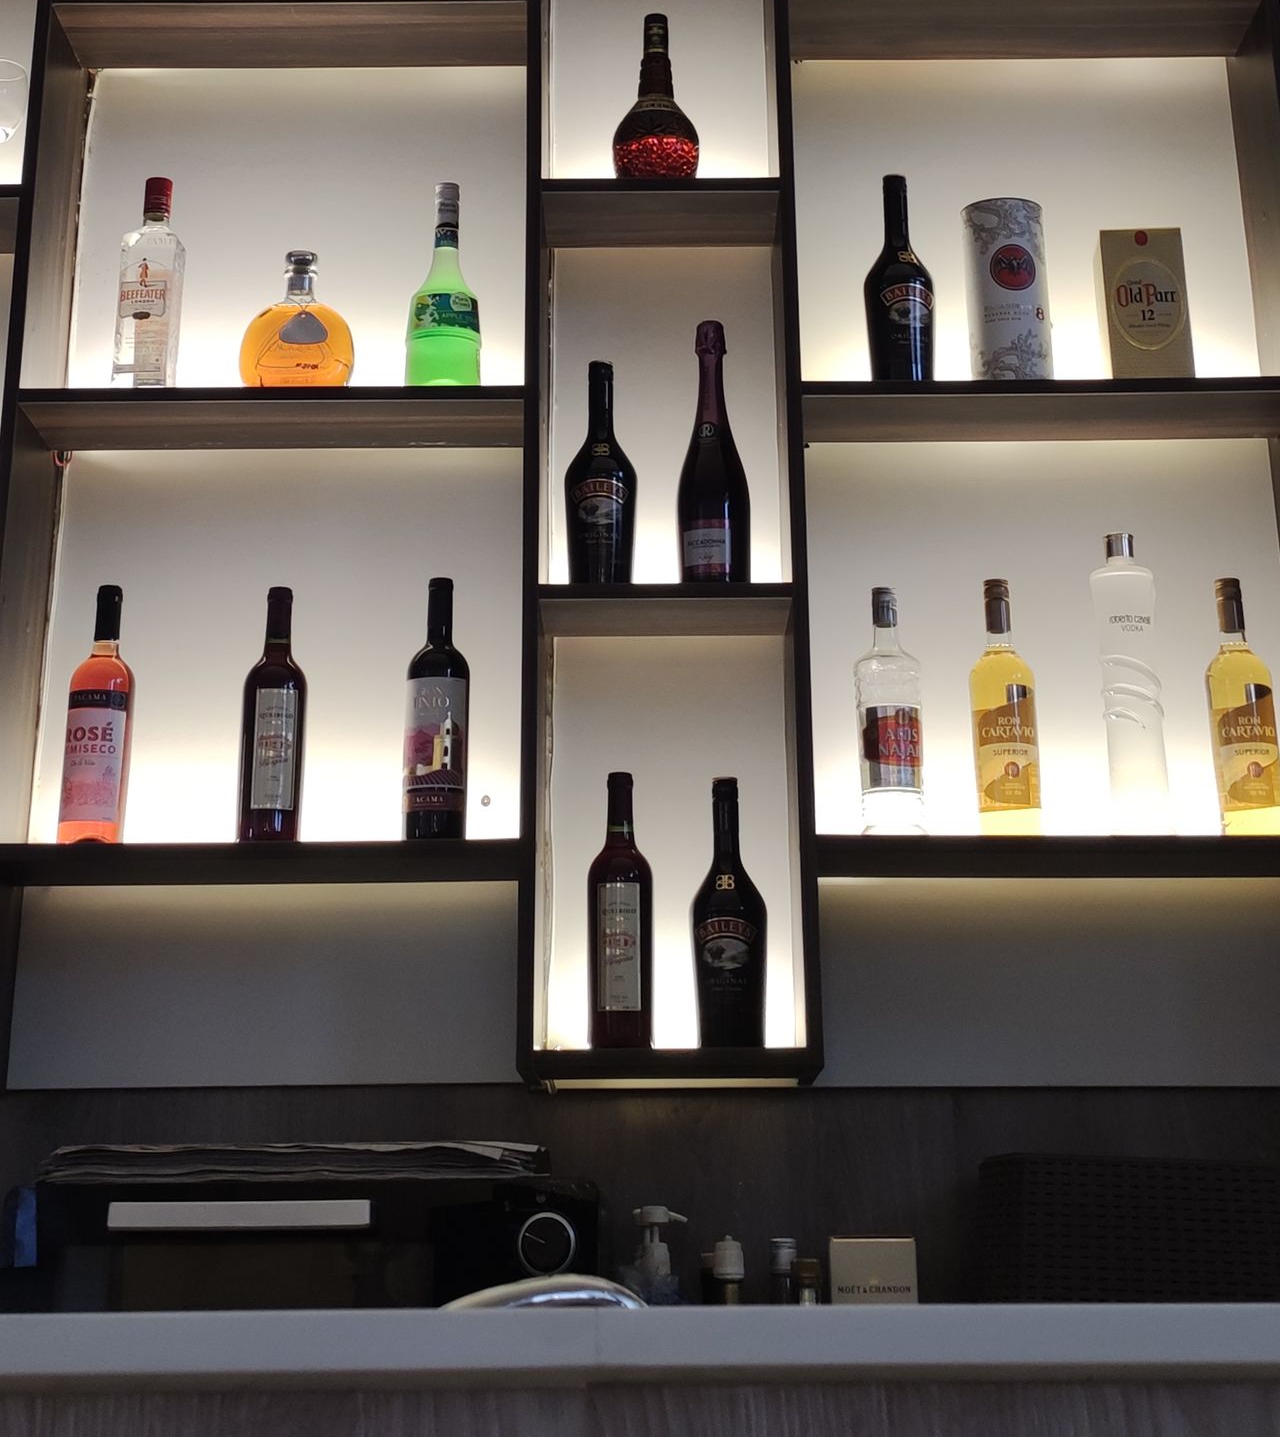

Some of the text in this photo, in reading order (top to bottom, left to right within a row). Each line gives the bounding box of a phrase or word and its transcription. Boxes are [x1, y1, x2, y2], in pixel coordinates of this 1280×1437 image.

[119, 289, 166, 303] BEEFEATER
[1116, 284, 1176, 308] Old Parr
[1035, 307, 1044, 323] 8
[1141, 310, 1155, 321] 12
[573, 480, 627, 500] BAILEYS
[997, 716, 1021, 727] RON
[1238, 716, 1261, 727] RON
[67, 721, 113, 743] ROSÉ
[981, 726, 1034, 740] CARTAVIO
[1221, 725, 1275, 738] CARTAVIO
[67, 744, 116, 755] MISECO
[992, 748, 1028, 756] SUPERIOR
[1234, 748, 1270, 756] SUPERIOR
[698, 919, 753, 938] BAILEYS
[837, 1284, 862, 1294] MOËT
[869, 1285, 912, 1294] CHANDON
